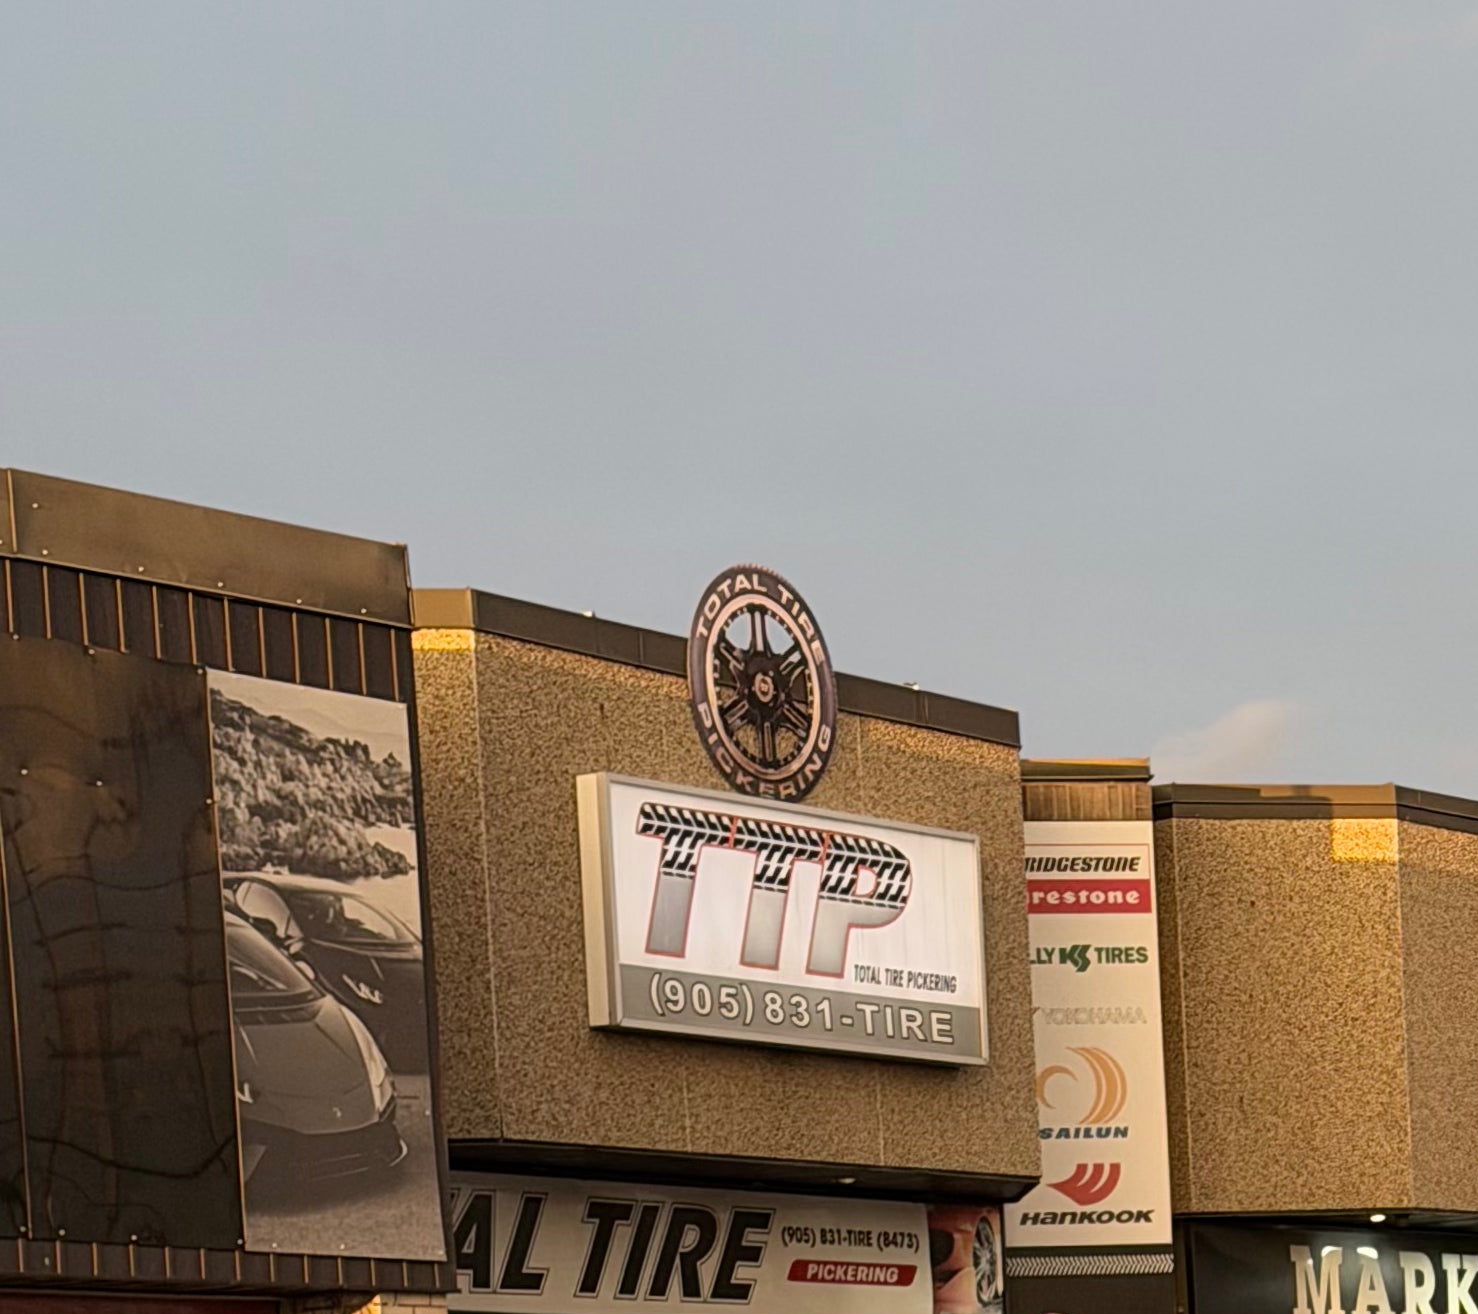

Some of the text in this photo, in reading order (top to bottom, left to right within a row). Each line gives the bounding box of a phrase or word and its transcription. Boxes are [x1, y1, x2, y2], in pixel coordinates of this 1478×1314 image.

[697, 573, 826, 666] TOTAL TIRE
[697, 701, 833, 800] PICKERING
[1024, 856, 1141, 873] RIDGESTONE
[1026, 889, 1140, 905] restone
[1094, 947, 1148, 964] TIRES
[854, 964, 957, 994] TOTAL TIRE PICKERING
[650, 971, 954, 1045] (905) 831-TIRE
[1040, 1126, 1129, 1139] SAILUN
[450, 1188, 776, 1305] AL TIRE
[781, 1226, 920, 1254] (905) 831-TIRE (8473)
[806, 1263, 899, 1283] PICKERING
